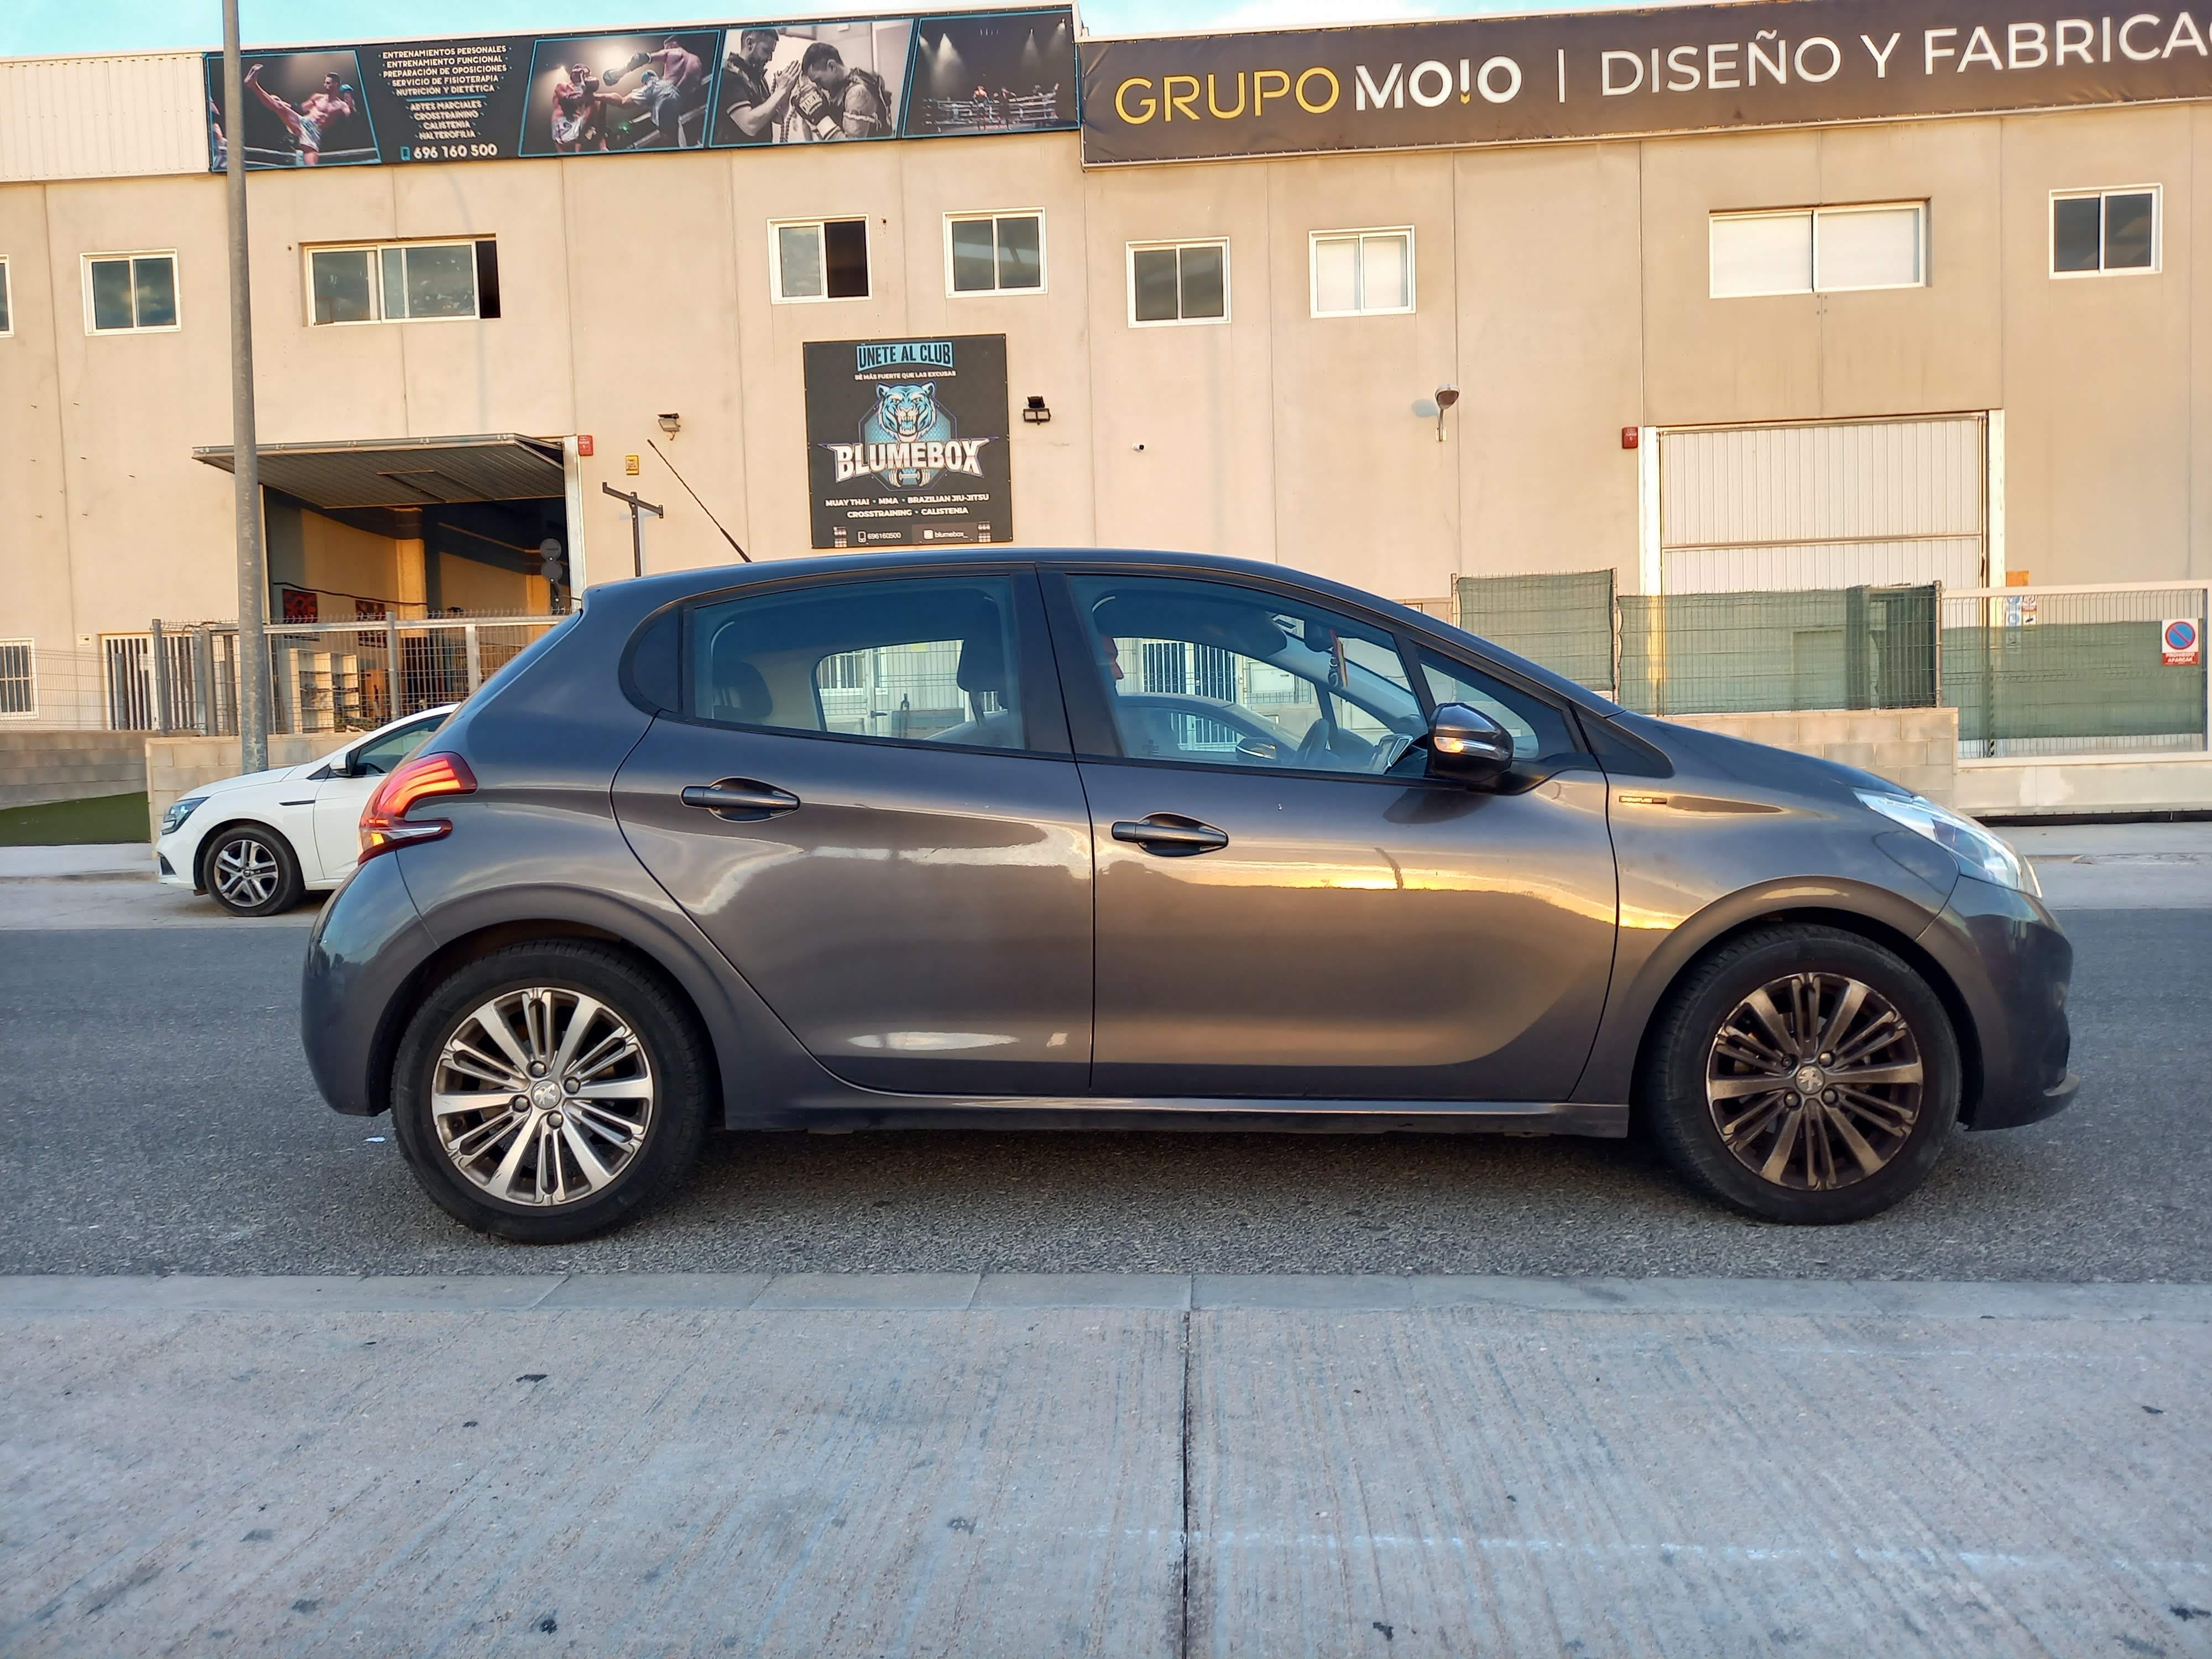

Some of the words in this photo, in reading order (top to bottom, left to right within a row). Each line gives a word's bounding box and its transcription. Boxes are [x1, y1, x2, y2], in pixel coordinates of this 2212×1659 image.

[383, 48, 455, 59] ENTRENAMIENTOS
[457, 45, 507, 55] PERSONALES
[387, 58, 455, 68] ENTRENAMIENTO
[457, 55, 503, 65] FUNCIONAL
[1115, 66, 1340, 125] GRUPO
[1601, 29, 1842, 97] DISEÑO
[1859, 32, 1901, 79] Y
[1923, 11, 2212, 75] FABRICA
[383, 67, 437, 78] PREPARACIÓN
[452, 65, 507, 74] OPOSICIONES
[392, 77, 430, 87] SERVICIO
[444, 74, 499, 85] FISIOTERAPIA
[396, 85, 441, 96] NUTRICIÓN
[451, 84, 495, 94] DIETÉTICA
[410, 102, 436, 111] ARTES
[436, 100, 482, 109] MARCIALES
[422, 120, 471, 130] CALISTENIA
[414, 145, 439, 159] 696
[441, 144, 467, 158] 160
[471, 143, 498, 156] 500
[858, 343, 896, 368] ÚNETE
[901, 345, 916, 361] AL
[920, 344, 951, 364] CLUB
[828, 438, 989, 482] BLUMEBOX
[907, 495, 952, 504] BRAZILIAN
[952, 493, 989, 502] JIU-JITSU
[847, 509, 912, 519] CROSSTRAINING
[921, 507, 969, 516] CALISTENIA
[867, 531, 901, 540] 696160500
